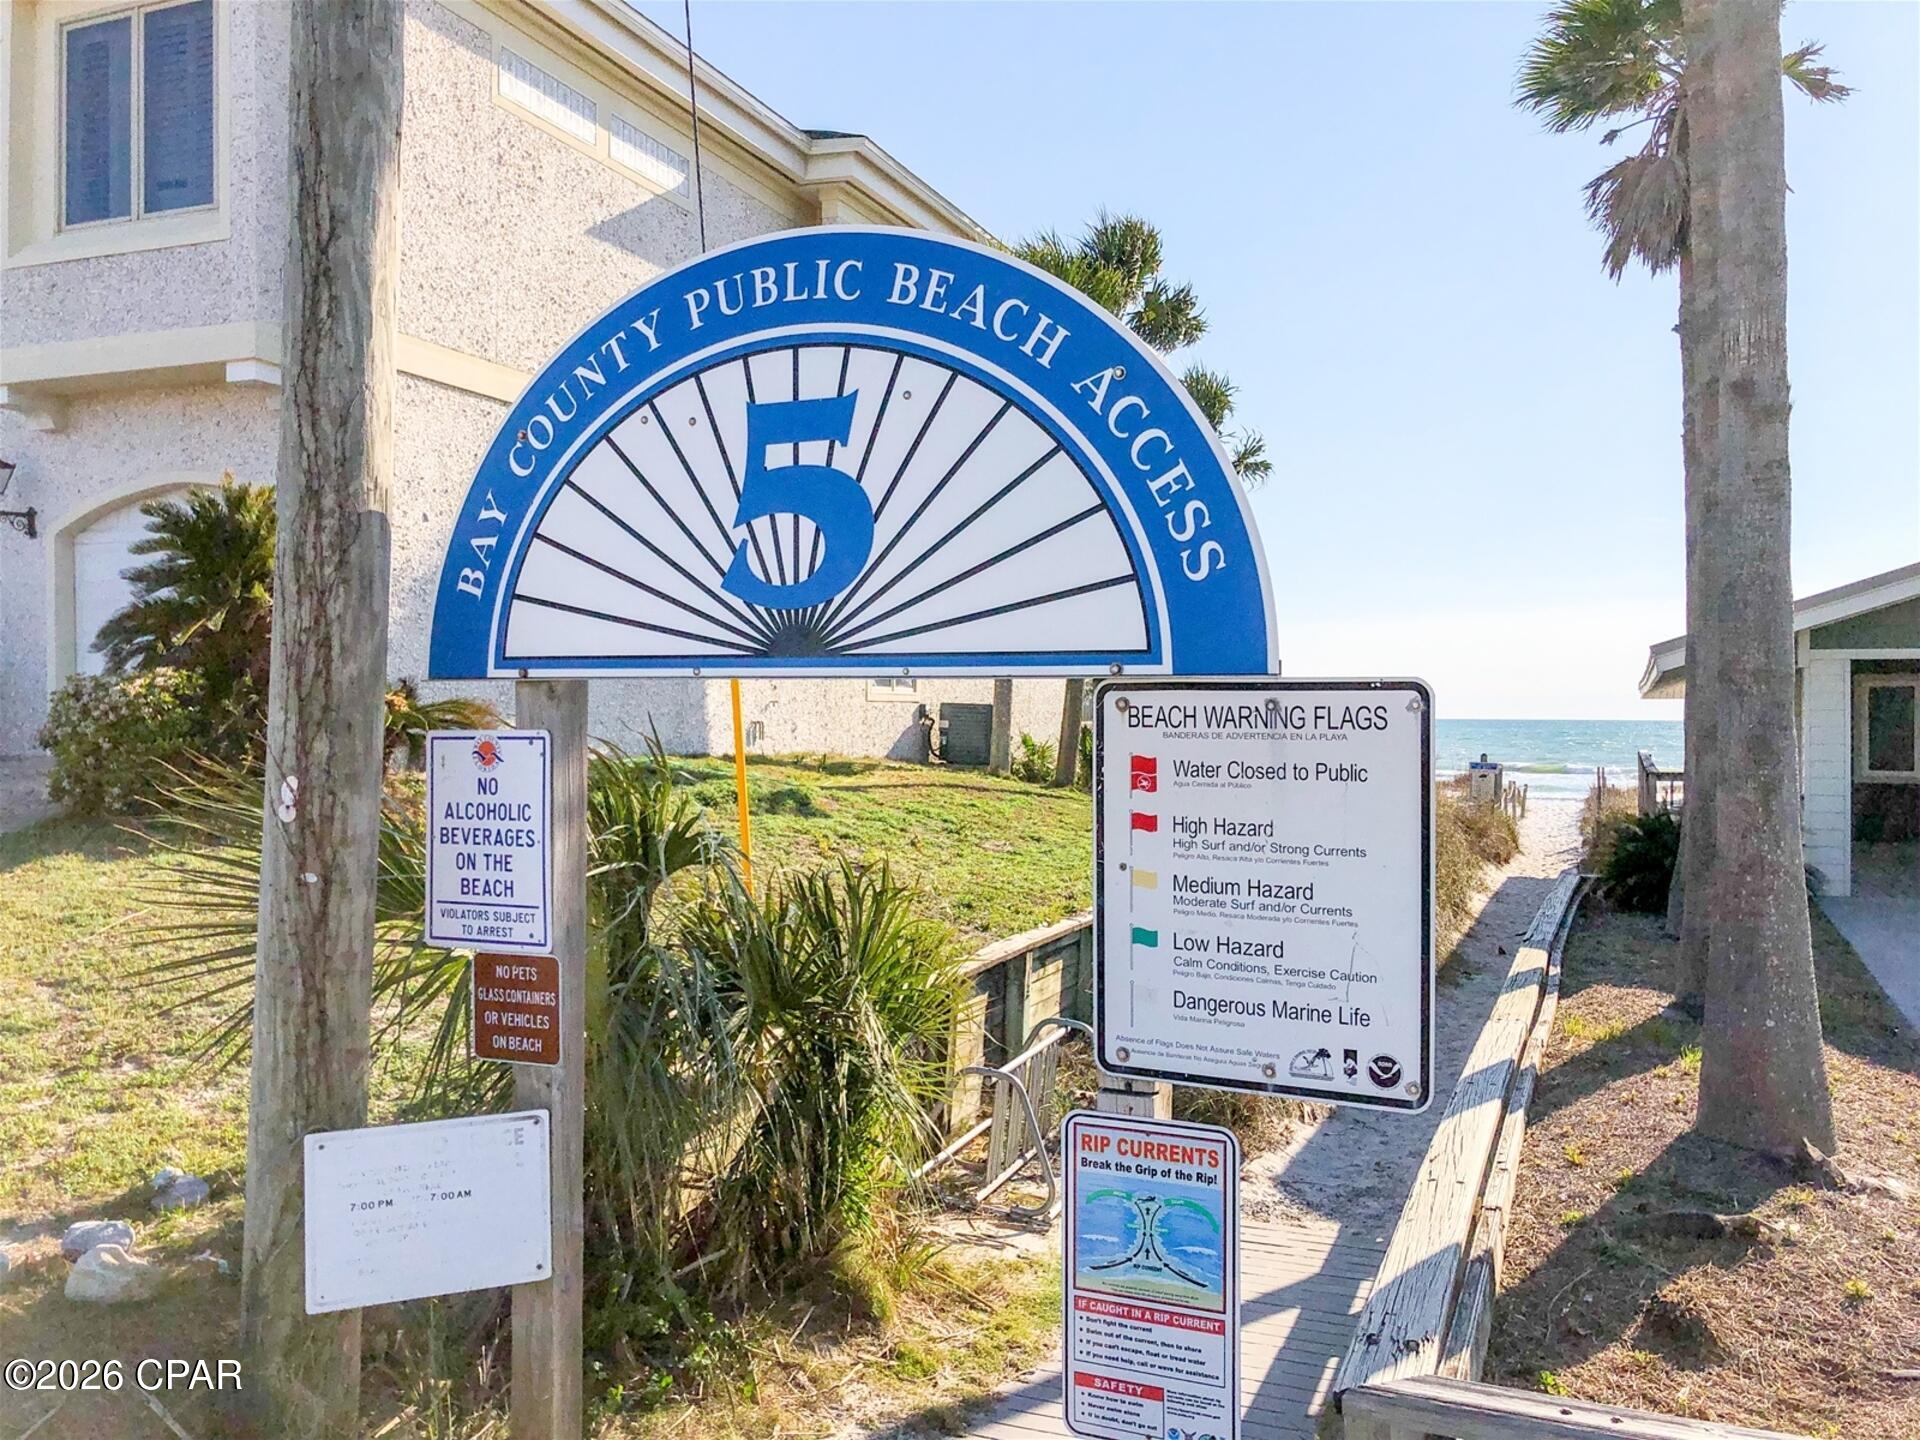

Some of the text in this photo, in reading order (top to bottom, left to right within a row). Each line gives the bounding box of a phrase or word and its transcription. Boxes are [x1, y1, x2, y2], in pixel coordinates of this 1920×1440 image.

[457, 259, 1226, 601] BAY COUNTY PUBLIC BEACH ACCESS
[720, 388, 875, 610] 5
[1128, 705, 1388, 730] BEACH WARNING FLAGS
[1162, 732, 1348, 741] BANDERAS DE ADVERTENCIA EN LA PLAYA
[1173, 760, 1368, 782] Water Closed to Public
[477, 777, 498, 796] NO
[444, 802, 532, 823] ALCOHOLIC
[1173, 816, 1274, 838] High Hazard
[440, 827, 535, 848] BEVERAGES
[1173, 838, 1367, 857] High Surf and/or Strong Currents
[456, 853, 513, 872] ON THE
[461, 878, 514, 898] BEACH
[1173, 874, 1313, 900] Medium Hazard
[440, 908, 536, 924] VIOLATORS SUBJECT
[1173, 895, 1353, 917] Moderate Surf and/or Currents
[462, 924, 513, 938] TO ARREST
[1173, 932, 1283, 958] Low Hazard
[496, 965, 537, 981] NO PETS
[1173, 955, 1377, 983] Calm Conditions, Exercise Caution
[478, 987, 556, 1006] GLASS CONTAINERS
[1173, 990, 1370, 1027] Dangerous Marine Life
[485, 1011, 549, 1029] OR VEHICLES
[493, 1035, 542, 1052] ON BEACH
[1081, 1133, 1219, 1168] RIP CURRENTS
[1081, 1157, 1218, 1187] Break the Grip of the Rip!
[430, 1189, 472, 1201] 7:00 AM
[350, 1199, 393, 1212] 7:00 PM
[1078, 1299, 1220, 1332] IF CAUGHT IN A RIP CURRENT
[1118, 1321, 1128, 1329] the
[1094, 1378, 1143, 1395] SAFETY
